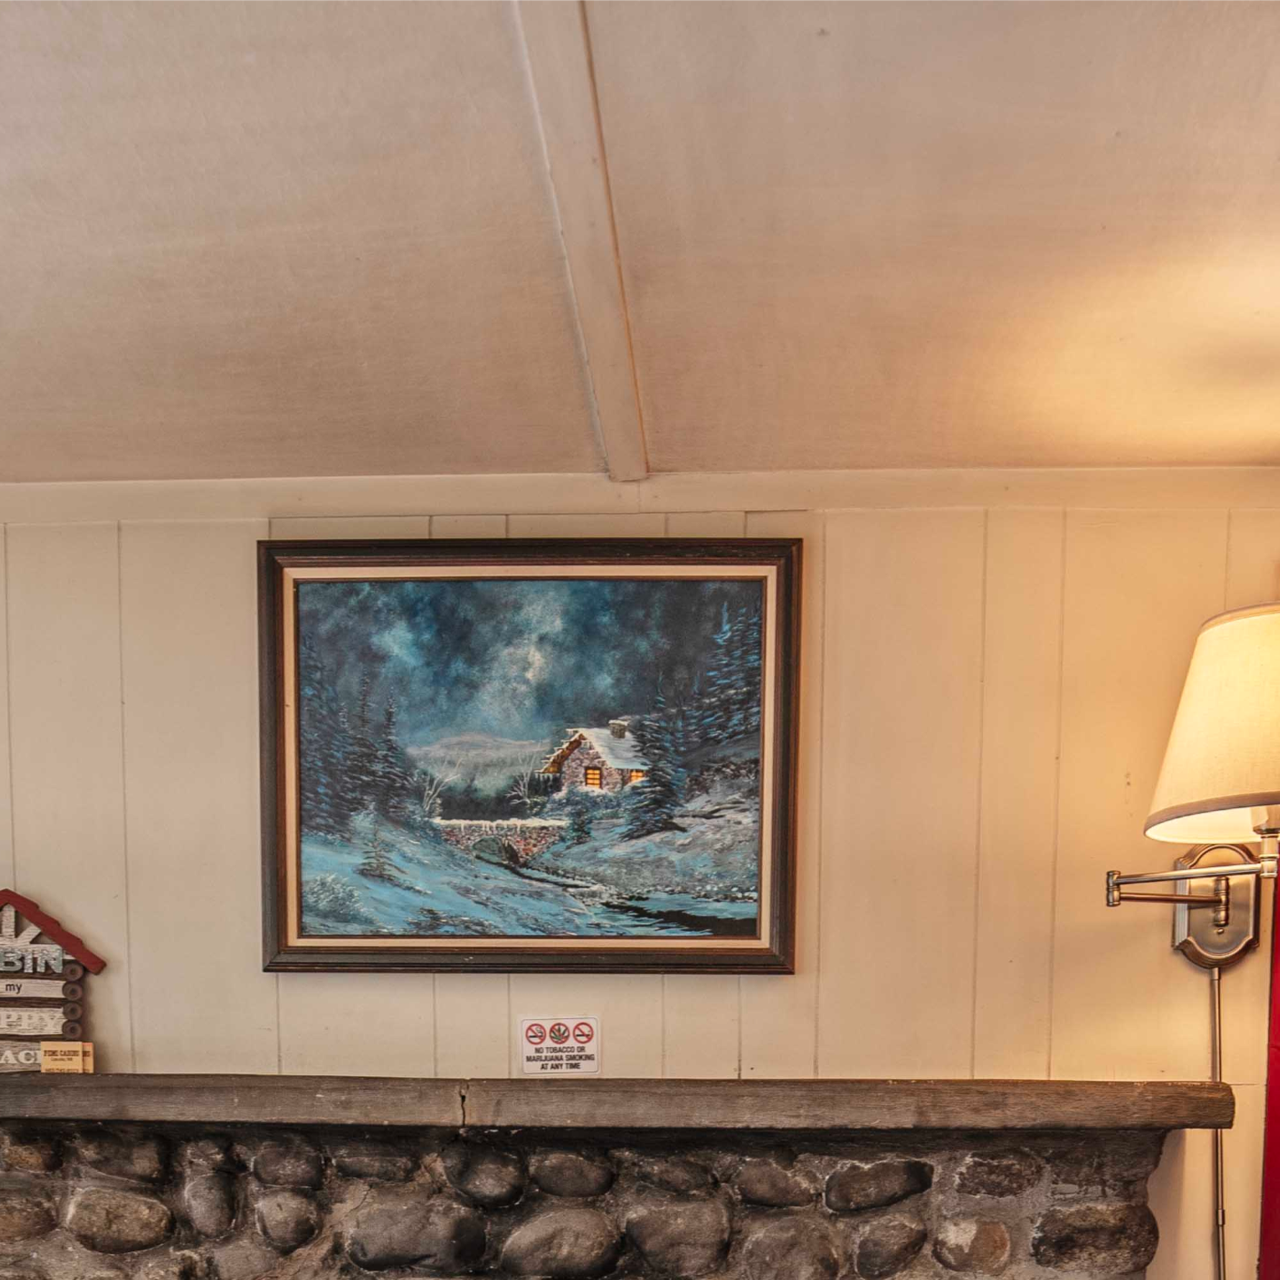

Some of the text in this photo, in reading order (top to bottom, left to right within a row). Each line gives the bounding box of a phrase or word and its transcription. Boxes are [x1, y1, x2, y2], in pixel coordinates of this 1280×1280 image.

[5, 983, 22, 994] my
[545, 1046, 575, 1054] TOBACCO
[565, 1062, 581, 1070] TIME
